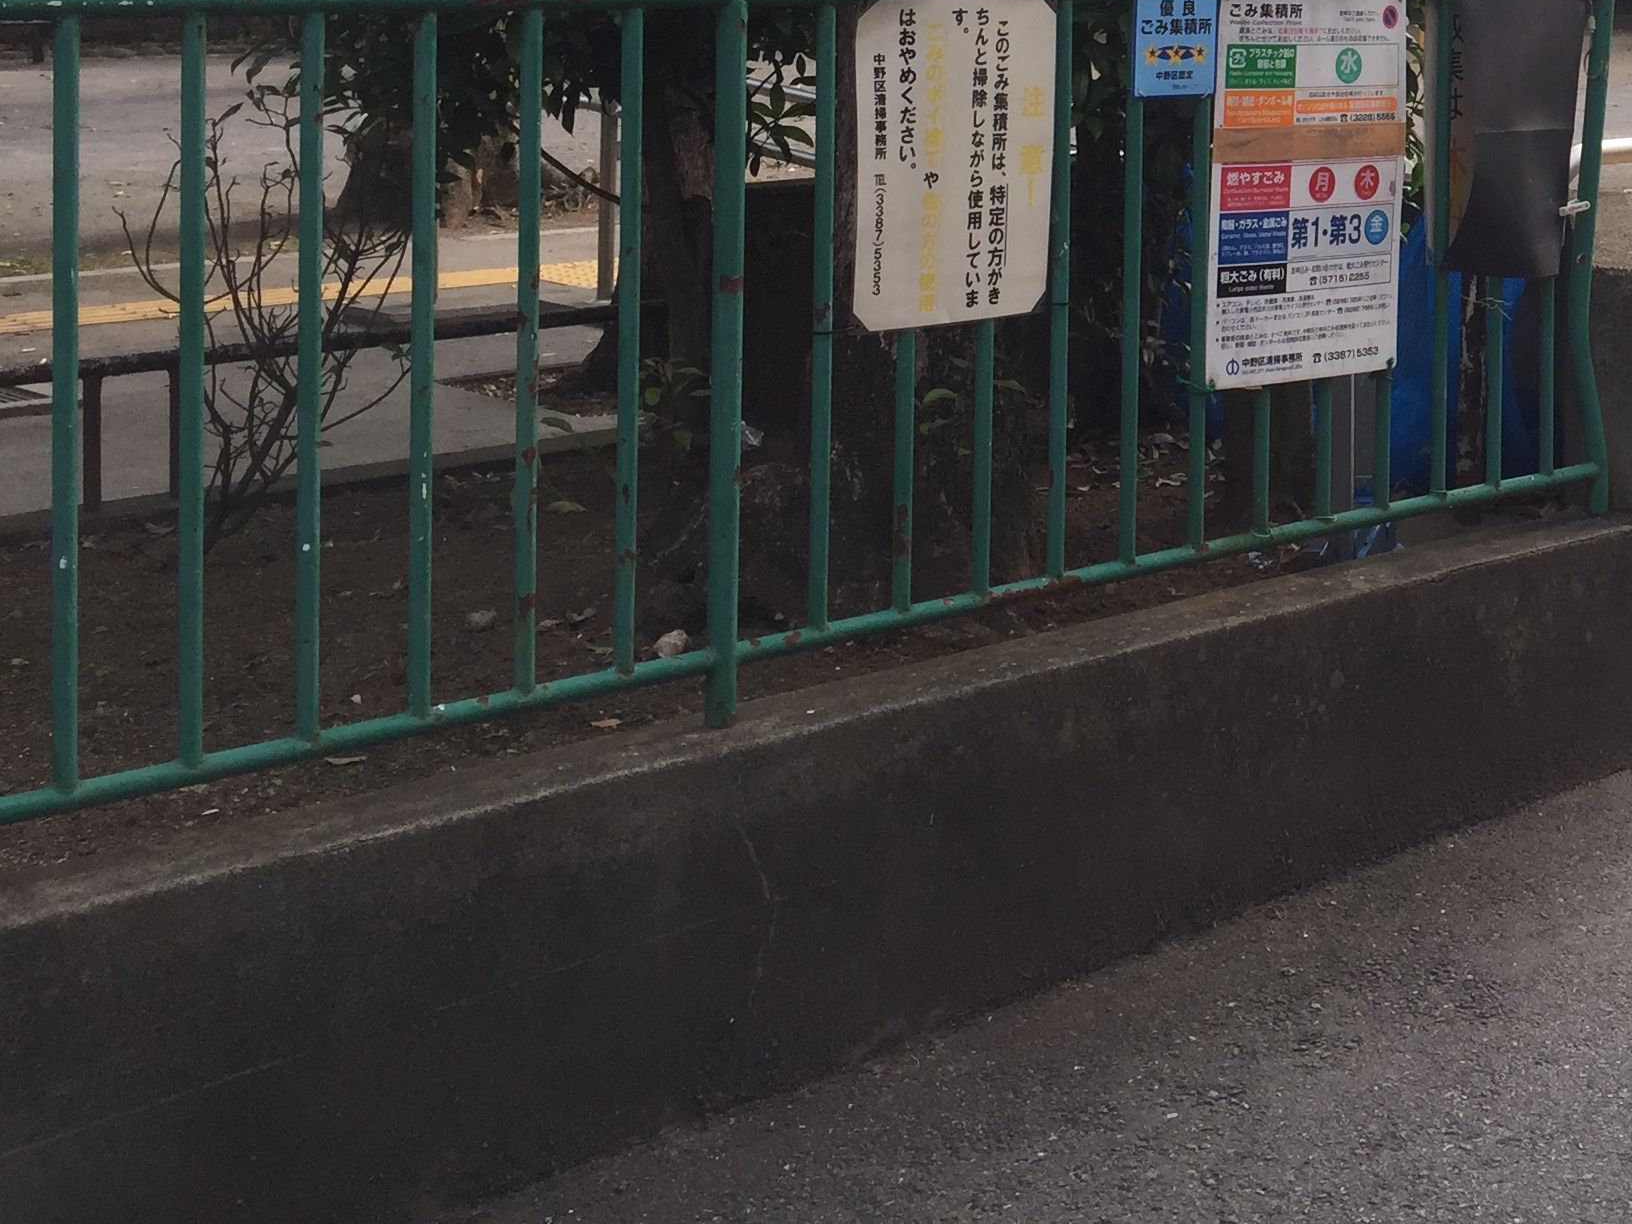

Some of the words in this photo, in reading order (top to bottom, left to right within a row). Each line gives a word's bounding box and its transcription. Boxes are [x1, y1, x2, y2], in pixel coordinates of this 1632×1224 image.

[1229, 3, 1303, 19] ごみ集積所
[1141, 17, 1213, 36] ごみ集積所
[1340, 51, 1358, 74] 水
[898, 8, 918, 171] はおやめください。
[964, 7, 990, 308] ちんと掃除しながら使用していま
[1315, 172, 1329, 191] 月
[1360, 169, 1375, 189] 木
[1370, 215, 1383, 233] 金
